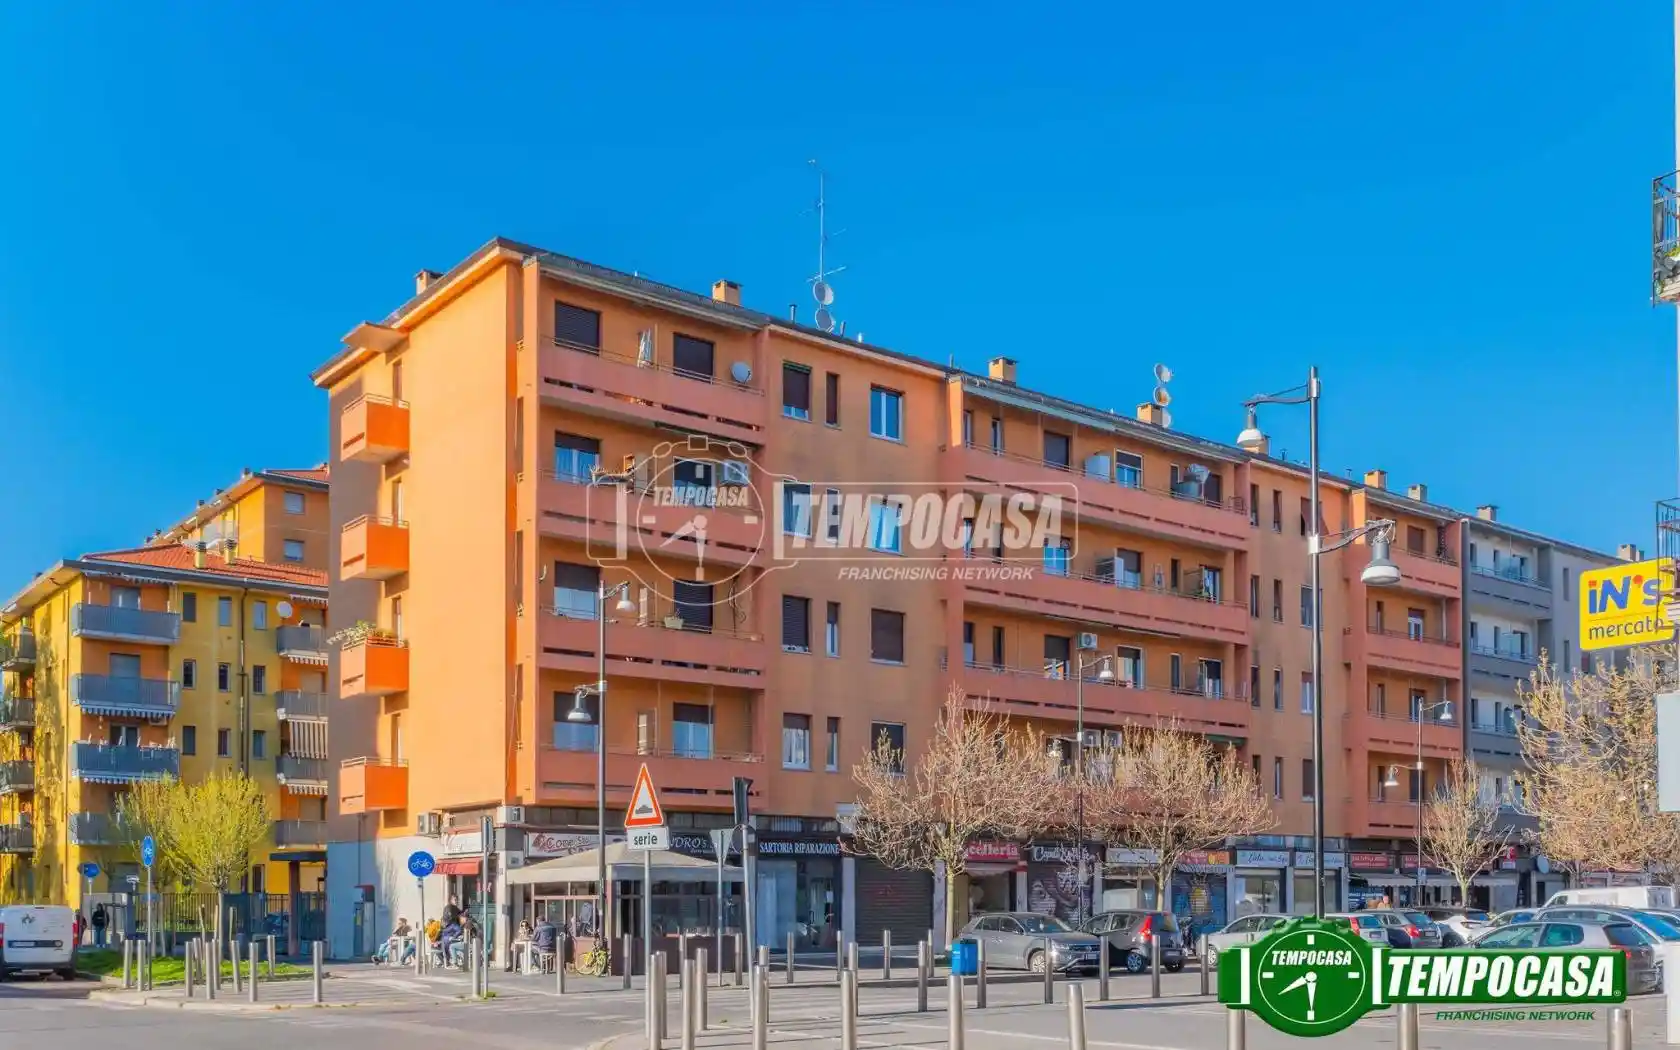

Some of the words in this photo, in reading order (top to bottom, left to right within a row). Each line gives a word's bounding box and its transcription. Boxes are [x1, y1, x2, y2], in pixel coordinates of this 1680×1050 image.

[1588, 615, 1665, 640] mercato
[633, 832, 658, 846] serie
[759, 841, 793, 853] SARTORIA
[794, 842, 840, 854] RIPARAZIONE
